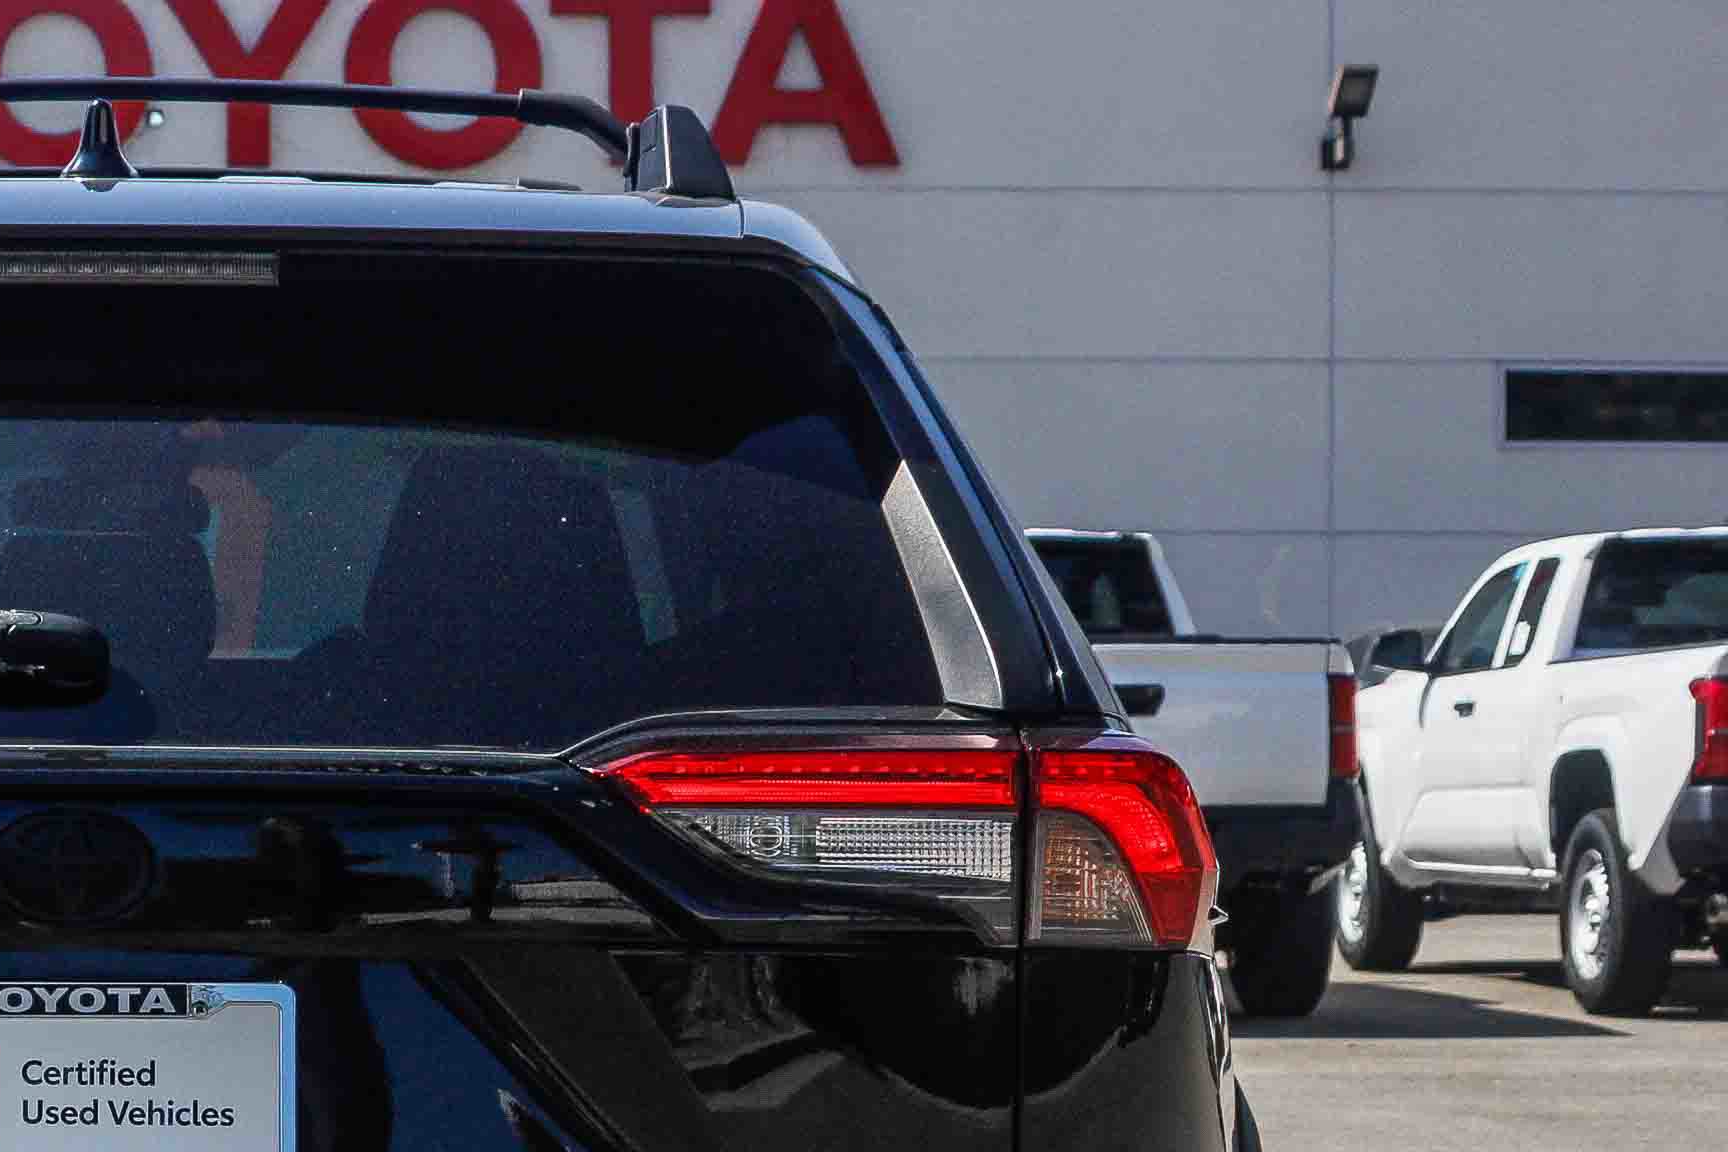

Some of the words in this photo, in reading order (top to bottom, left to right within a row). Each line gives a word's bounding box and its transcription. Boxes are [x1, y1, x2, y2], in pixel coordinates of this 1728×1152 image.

[21, 1059, 157, 1087] Certified
[21, 1099, 100, 1127] Used
[108, 1099, 235, 1128] Vehicles
